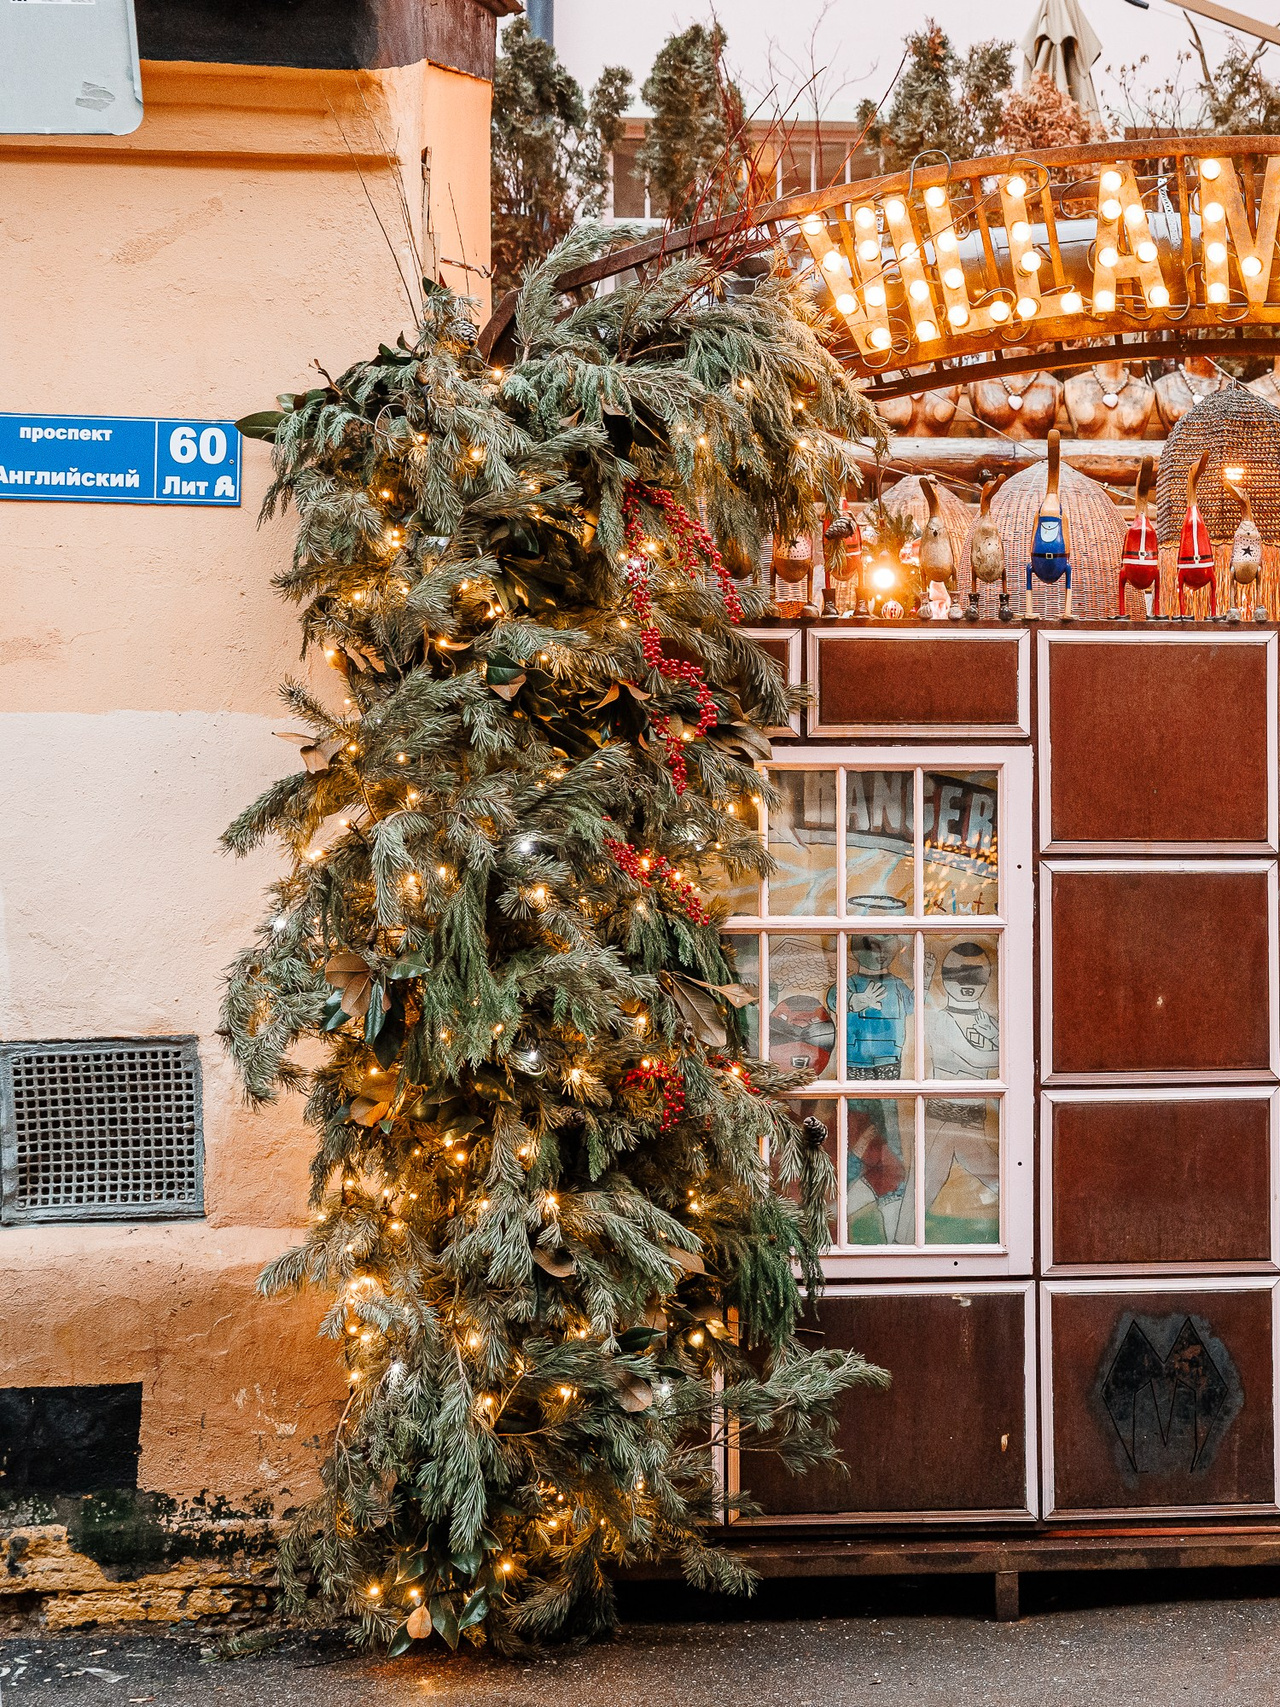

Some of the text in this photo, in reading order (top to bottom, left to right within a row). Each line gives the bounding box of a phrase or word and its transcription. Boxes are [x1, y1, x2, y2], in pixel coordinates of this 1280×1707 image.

[797, 162, 1170, 356] VILLA
[19, 426, 113, 442] проспект
[169, 426, 228, 465] 60
[162, 475, 209, 496] Лит
